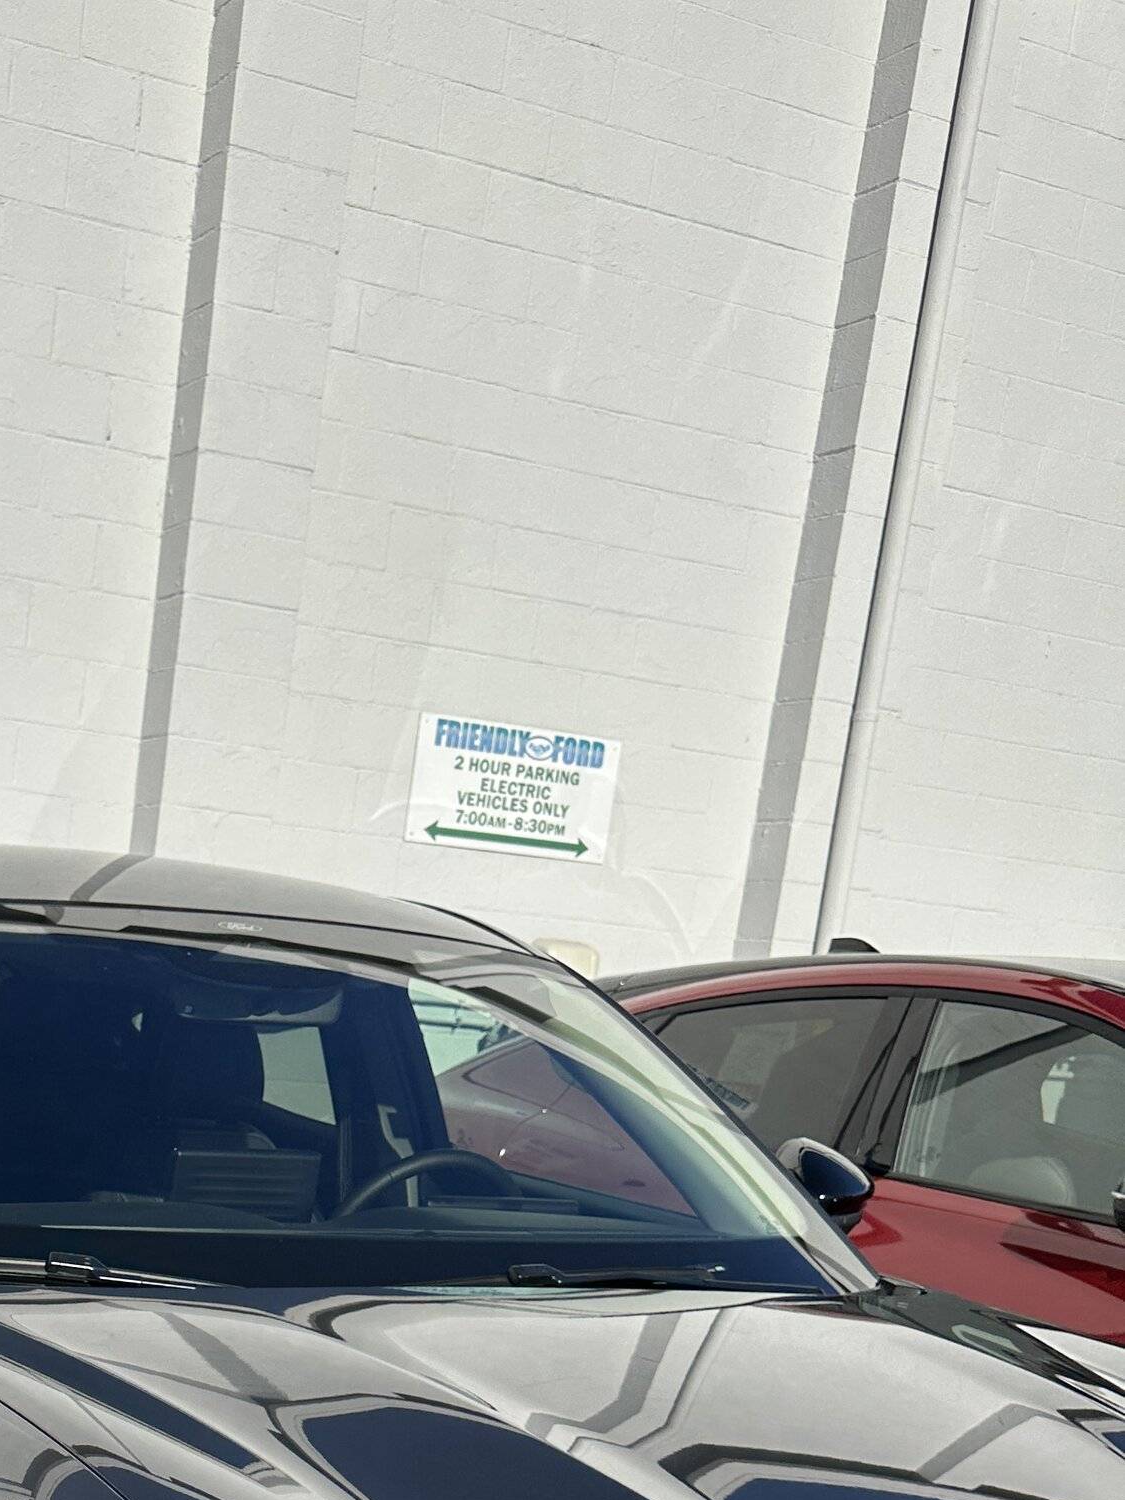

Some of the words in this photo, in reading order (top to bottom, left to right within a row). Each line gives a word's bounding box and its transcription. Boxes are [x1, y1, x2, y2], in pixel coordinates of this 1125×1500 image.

[434, 718, 531, 758] FRIENDLY
[552, 735, 605, 769] FORD
[454, 755, 465, 770] 2
[468, 757, 511, 777] HOUR
[515, 763, 580, 786] PARKING
[480, 778, 551, 800] ELECTRIC
[457, 790, 528, 813] VEHICLES
[533, 801, 570, 819] ONLY
